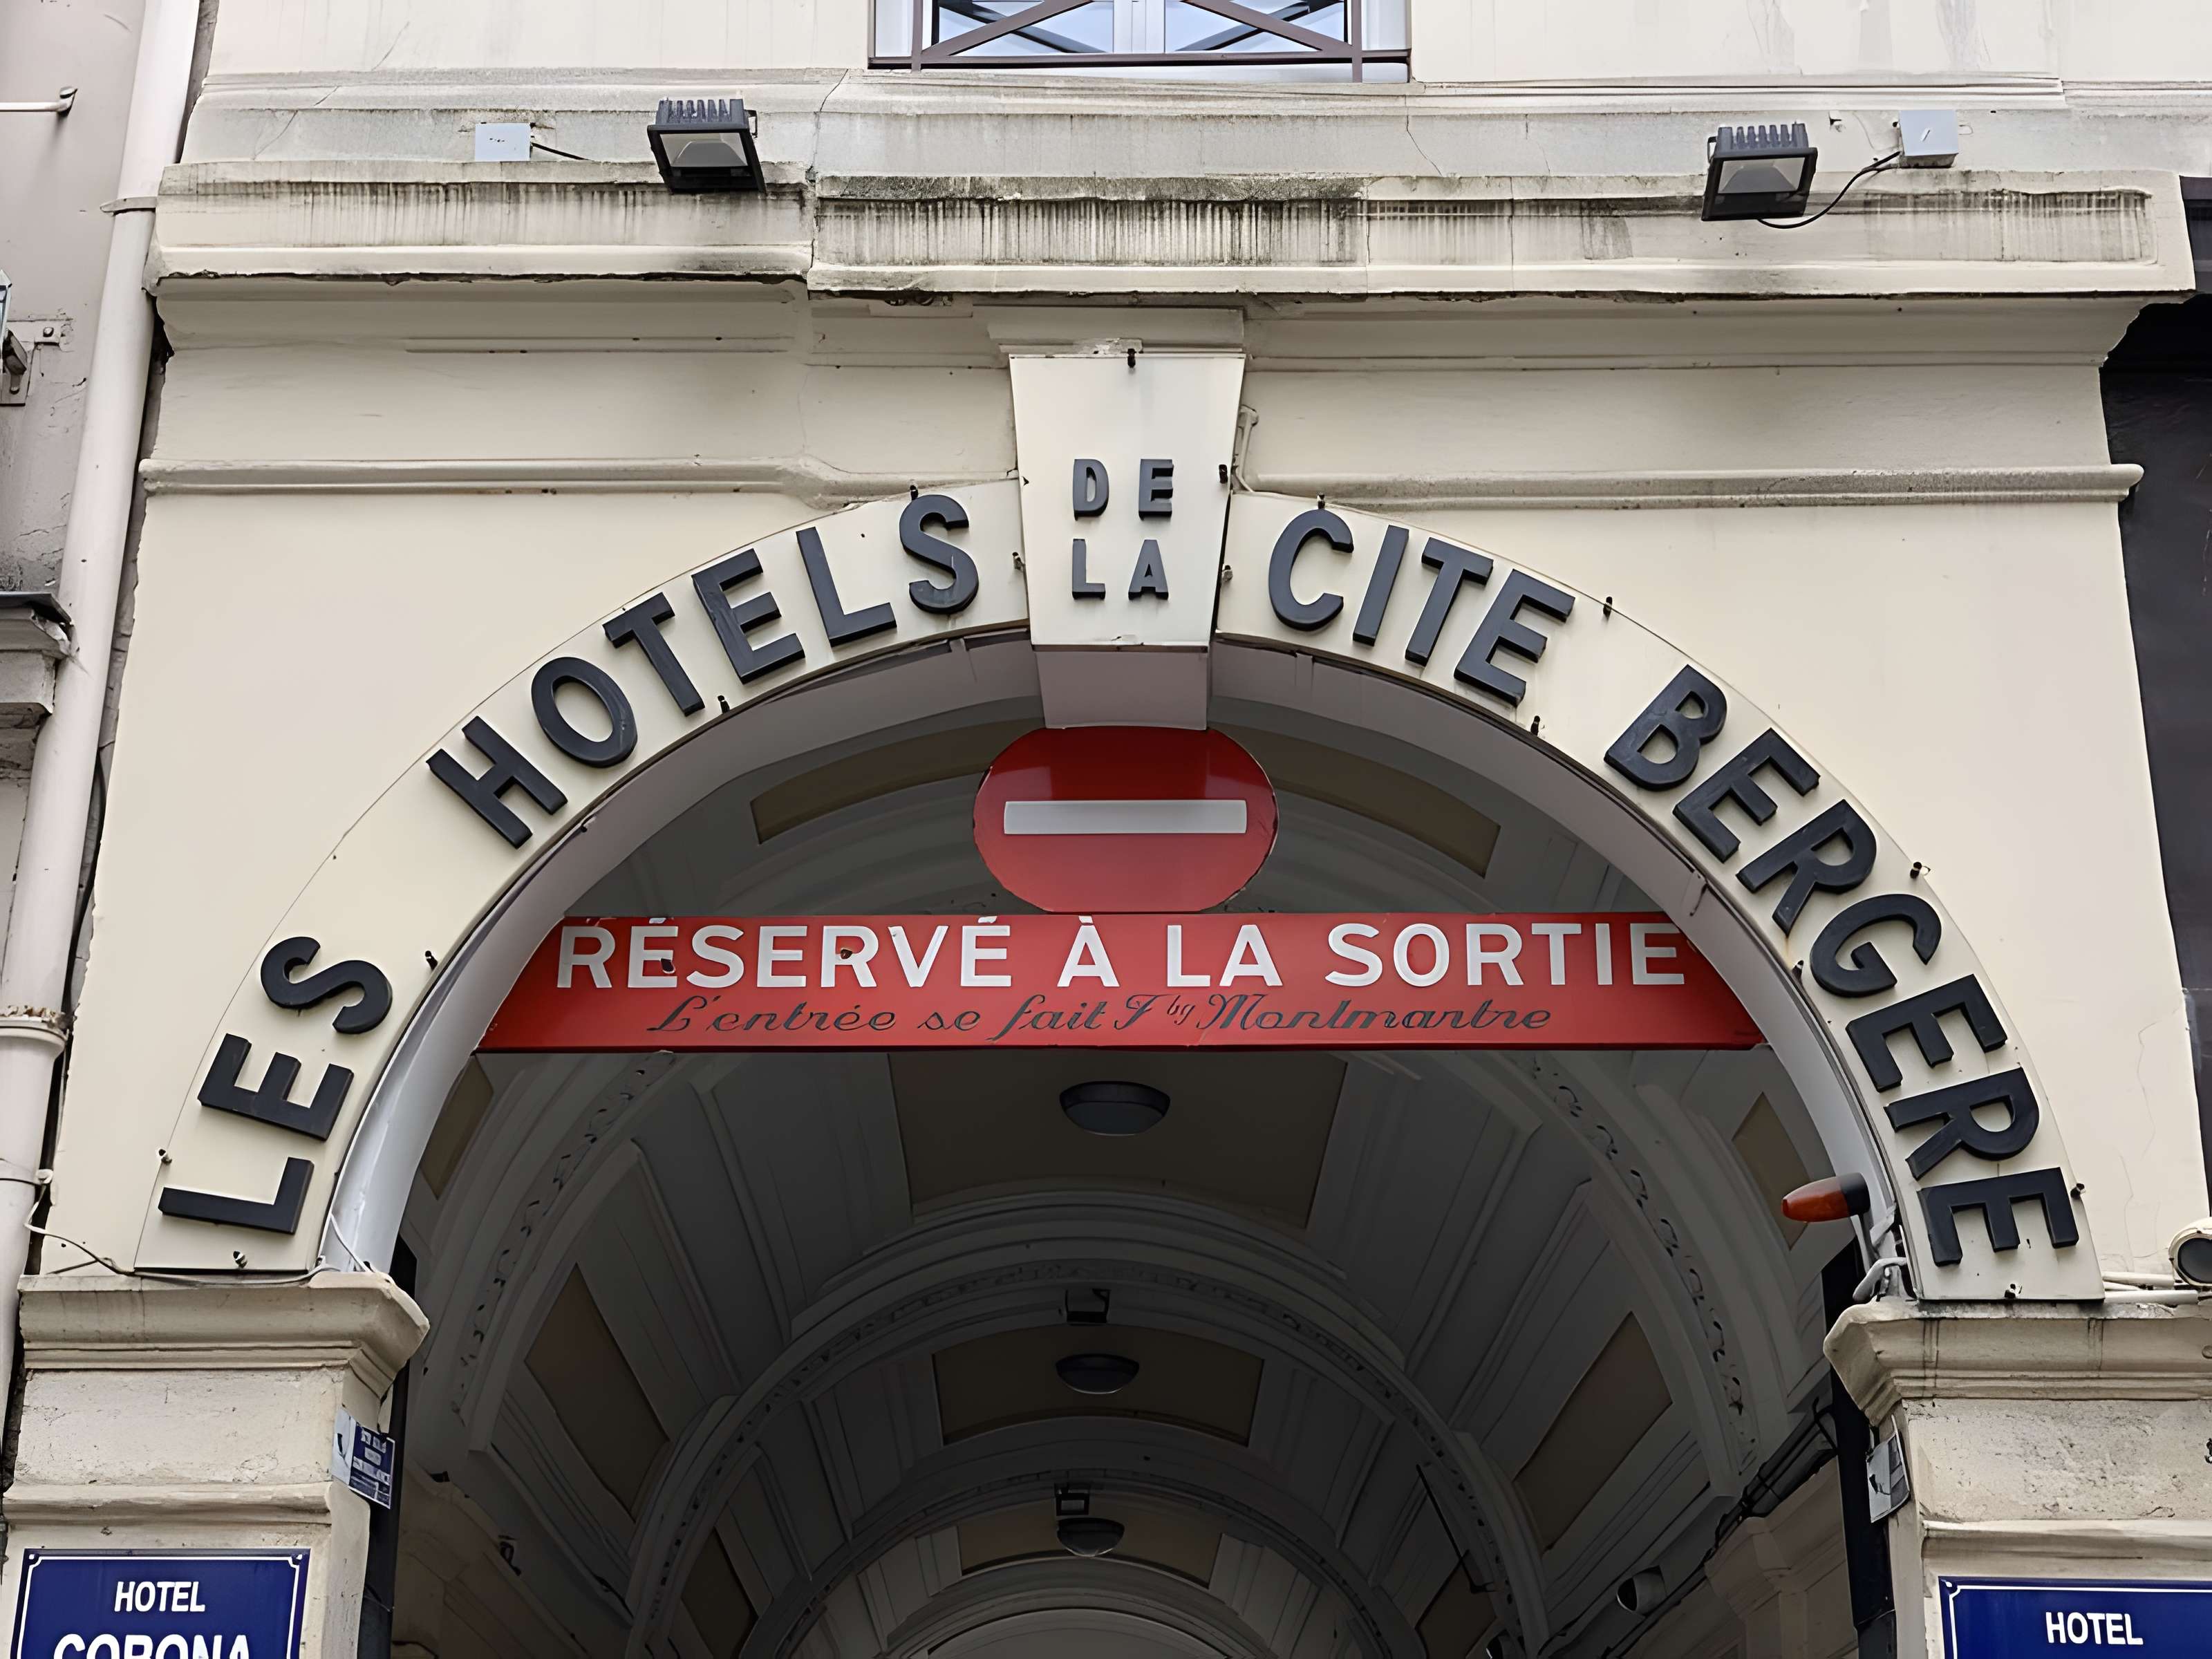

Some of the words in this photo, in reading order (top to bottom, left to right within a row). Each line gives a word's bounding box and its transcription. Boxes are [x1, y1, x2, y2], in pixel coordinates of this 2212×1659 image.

[1072, 458, 1174, 520] DE
[1071, 538, 1170, 600] LA
[158, 936, 393, 1235] LES
[425, 494, 980, 849] HOTELS
[1268, 509, 1576, 707] CITE
[1604, 664, 2079, 1266] BERGERE
[556, 916, 1012, 988] RÉSERVÉ
[1057, 915, 1120, 988] À
[1166, 924, 1283, 988] LA
[1324, 923, 1685, 988] SORTIE
[647, 995, 897, 1032] L'entrée
[917, 1009, 981, 1031] se
[984, 994, 1109, 1044] fait
[1196, 993, 1552, 1031] Montmartre
[113, 1581, 206, 1613] HOTEL
[2045, 1612, 2144, 1646] HOTEL
